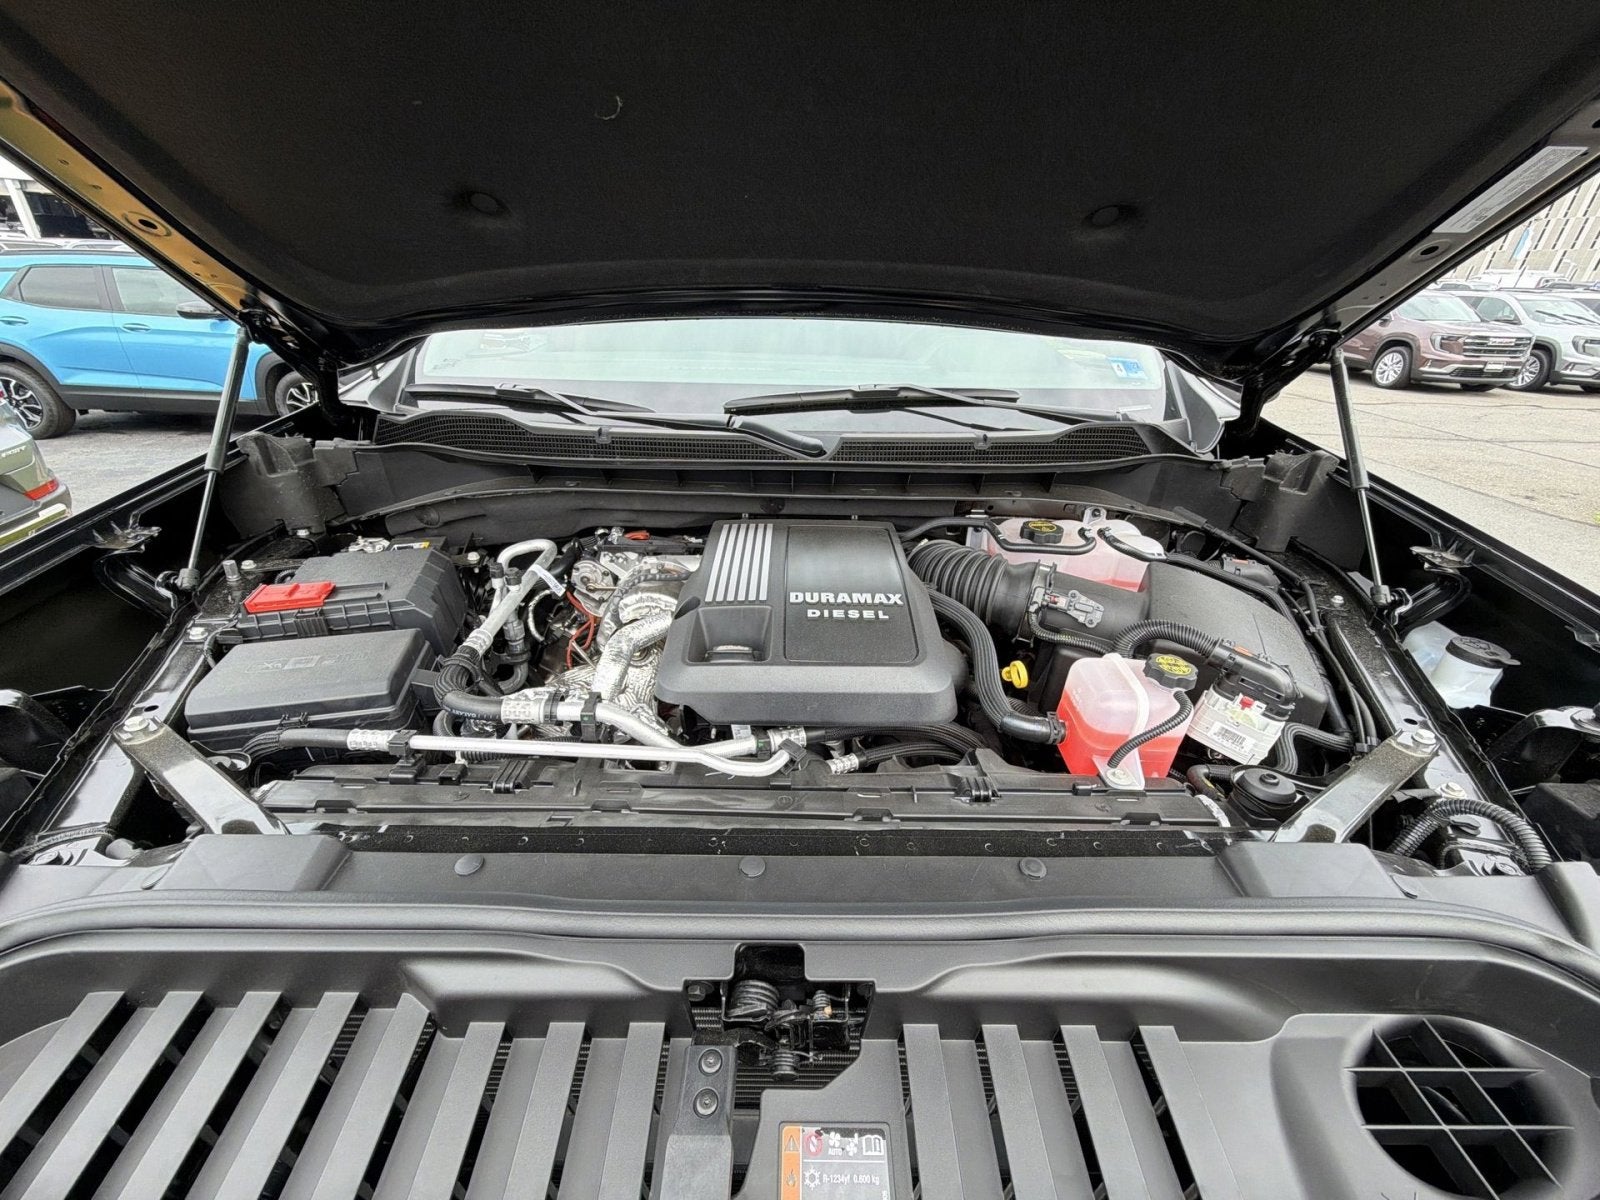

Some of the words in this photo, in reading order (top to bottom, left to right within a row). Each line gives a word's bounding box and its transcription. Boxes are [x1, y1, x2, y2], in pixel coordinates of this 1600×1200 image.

[789, 592, 903, 605] DURAMAX
[807, 609, 889, 619] DIESEL
[828, 1148, 842, 1156] AUTO
